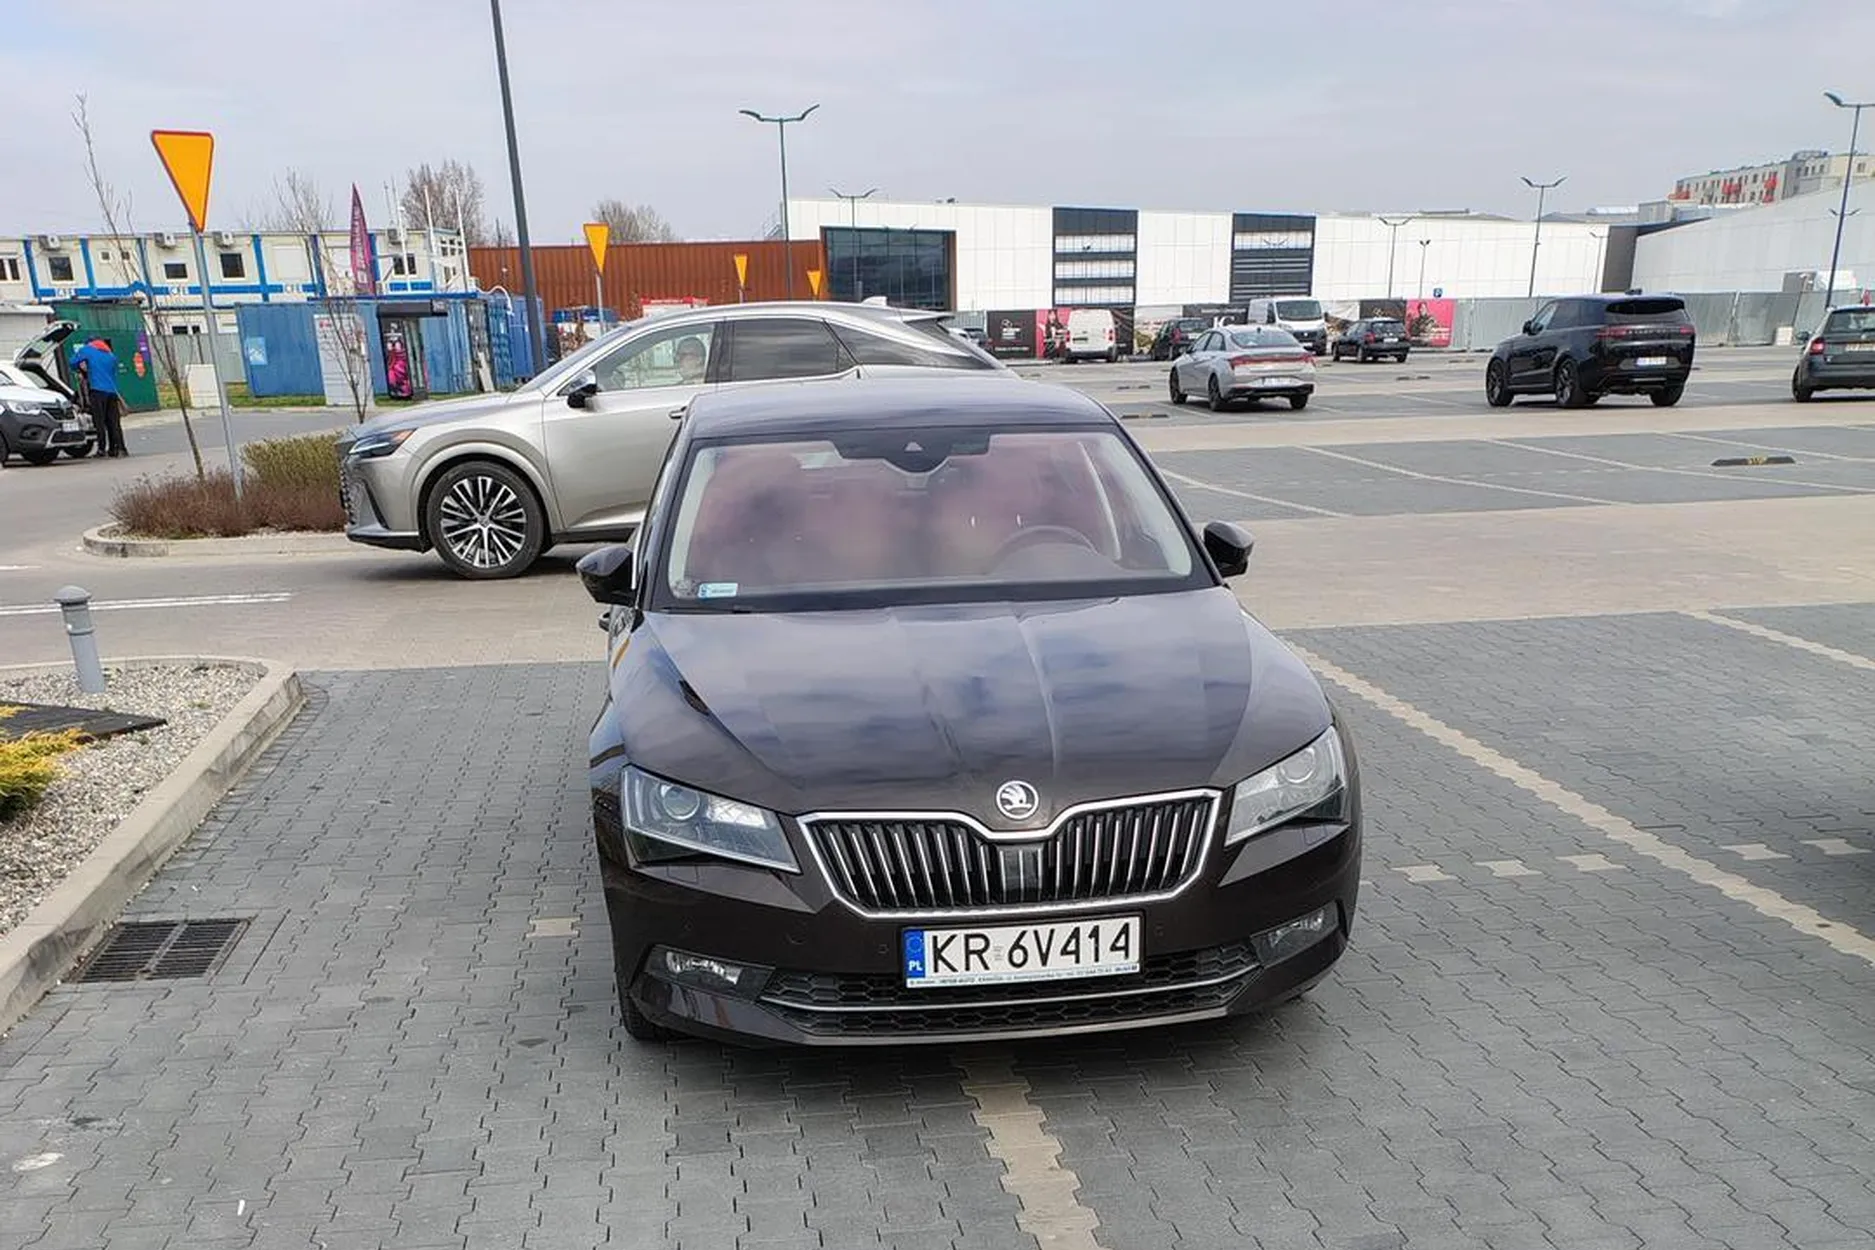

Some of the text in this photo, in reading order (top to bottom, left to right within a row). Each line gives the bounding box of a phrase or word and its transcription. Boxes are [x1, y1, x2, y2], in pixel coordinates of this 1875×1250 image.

[931, 922, 1130, 973] KR 6V414
[908, 961, 923, 972] PL
